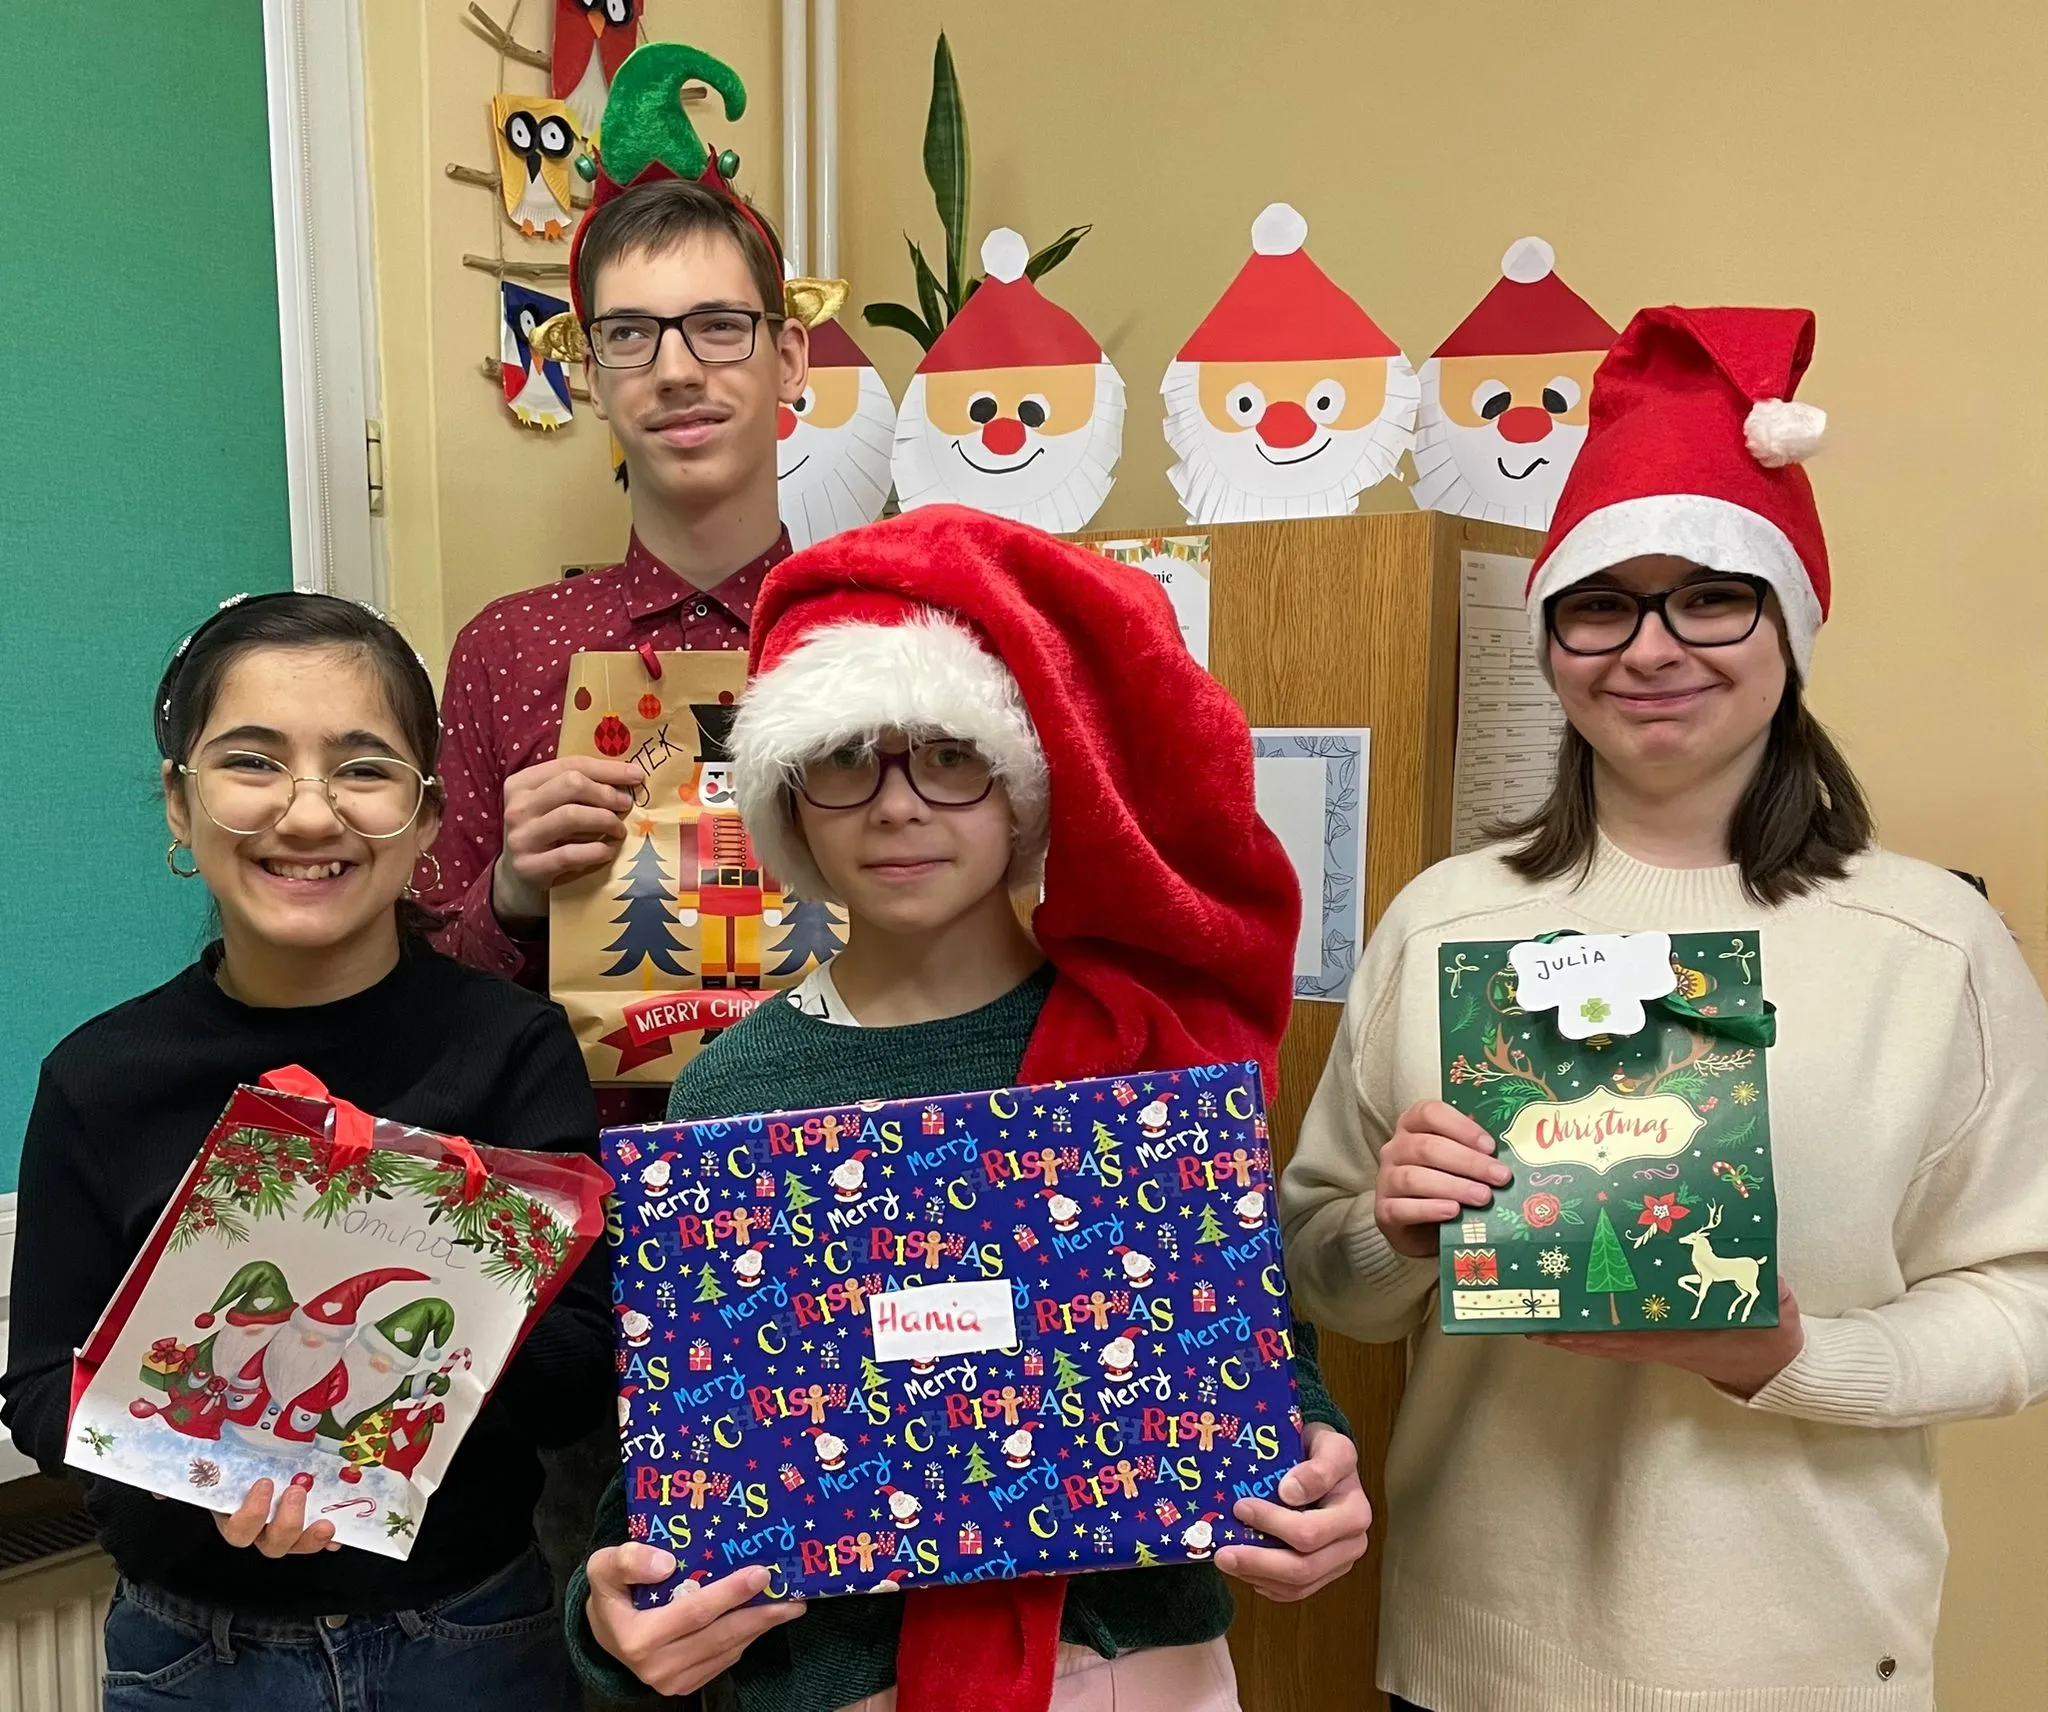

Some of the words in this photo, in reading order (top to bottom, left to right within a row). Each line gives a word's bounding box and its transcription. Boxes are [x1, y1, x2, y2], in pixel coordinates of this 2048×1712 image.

[635, 1000, 699, 1033] MERRY
[1135, 1121, 1209, 1168] Merry
[1536, 1106, 1673, 1150] Christmas
[907, 1131, 978, 1176] Merry
[637, 1181, 711, 1226] Merry
[827, 1187, 900, 1234] Merry
[1051, 1213, 1125, 1260] Merry
[1221, 1218, 1283, 1271] Merry
[719, 1277, 788, 1329] Merry
[878, 1301, 983, 1334] Hania
[1177, 1308, 1251, 1355] Merry
[673, 1367, 746, 1414] Merry
[903, 1358, 978, 1406] Merry
[1097, 1367, 1171, 1415] Merry
[819, 1452, 892, 1499] Merry
[988, 1457, 1060, 1512] Merry
[721, 1517, 796, 1564] Merry
[943, 1551, 1017, 1585] Merry
